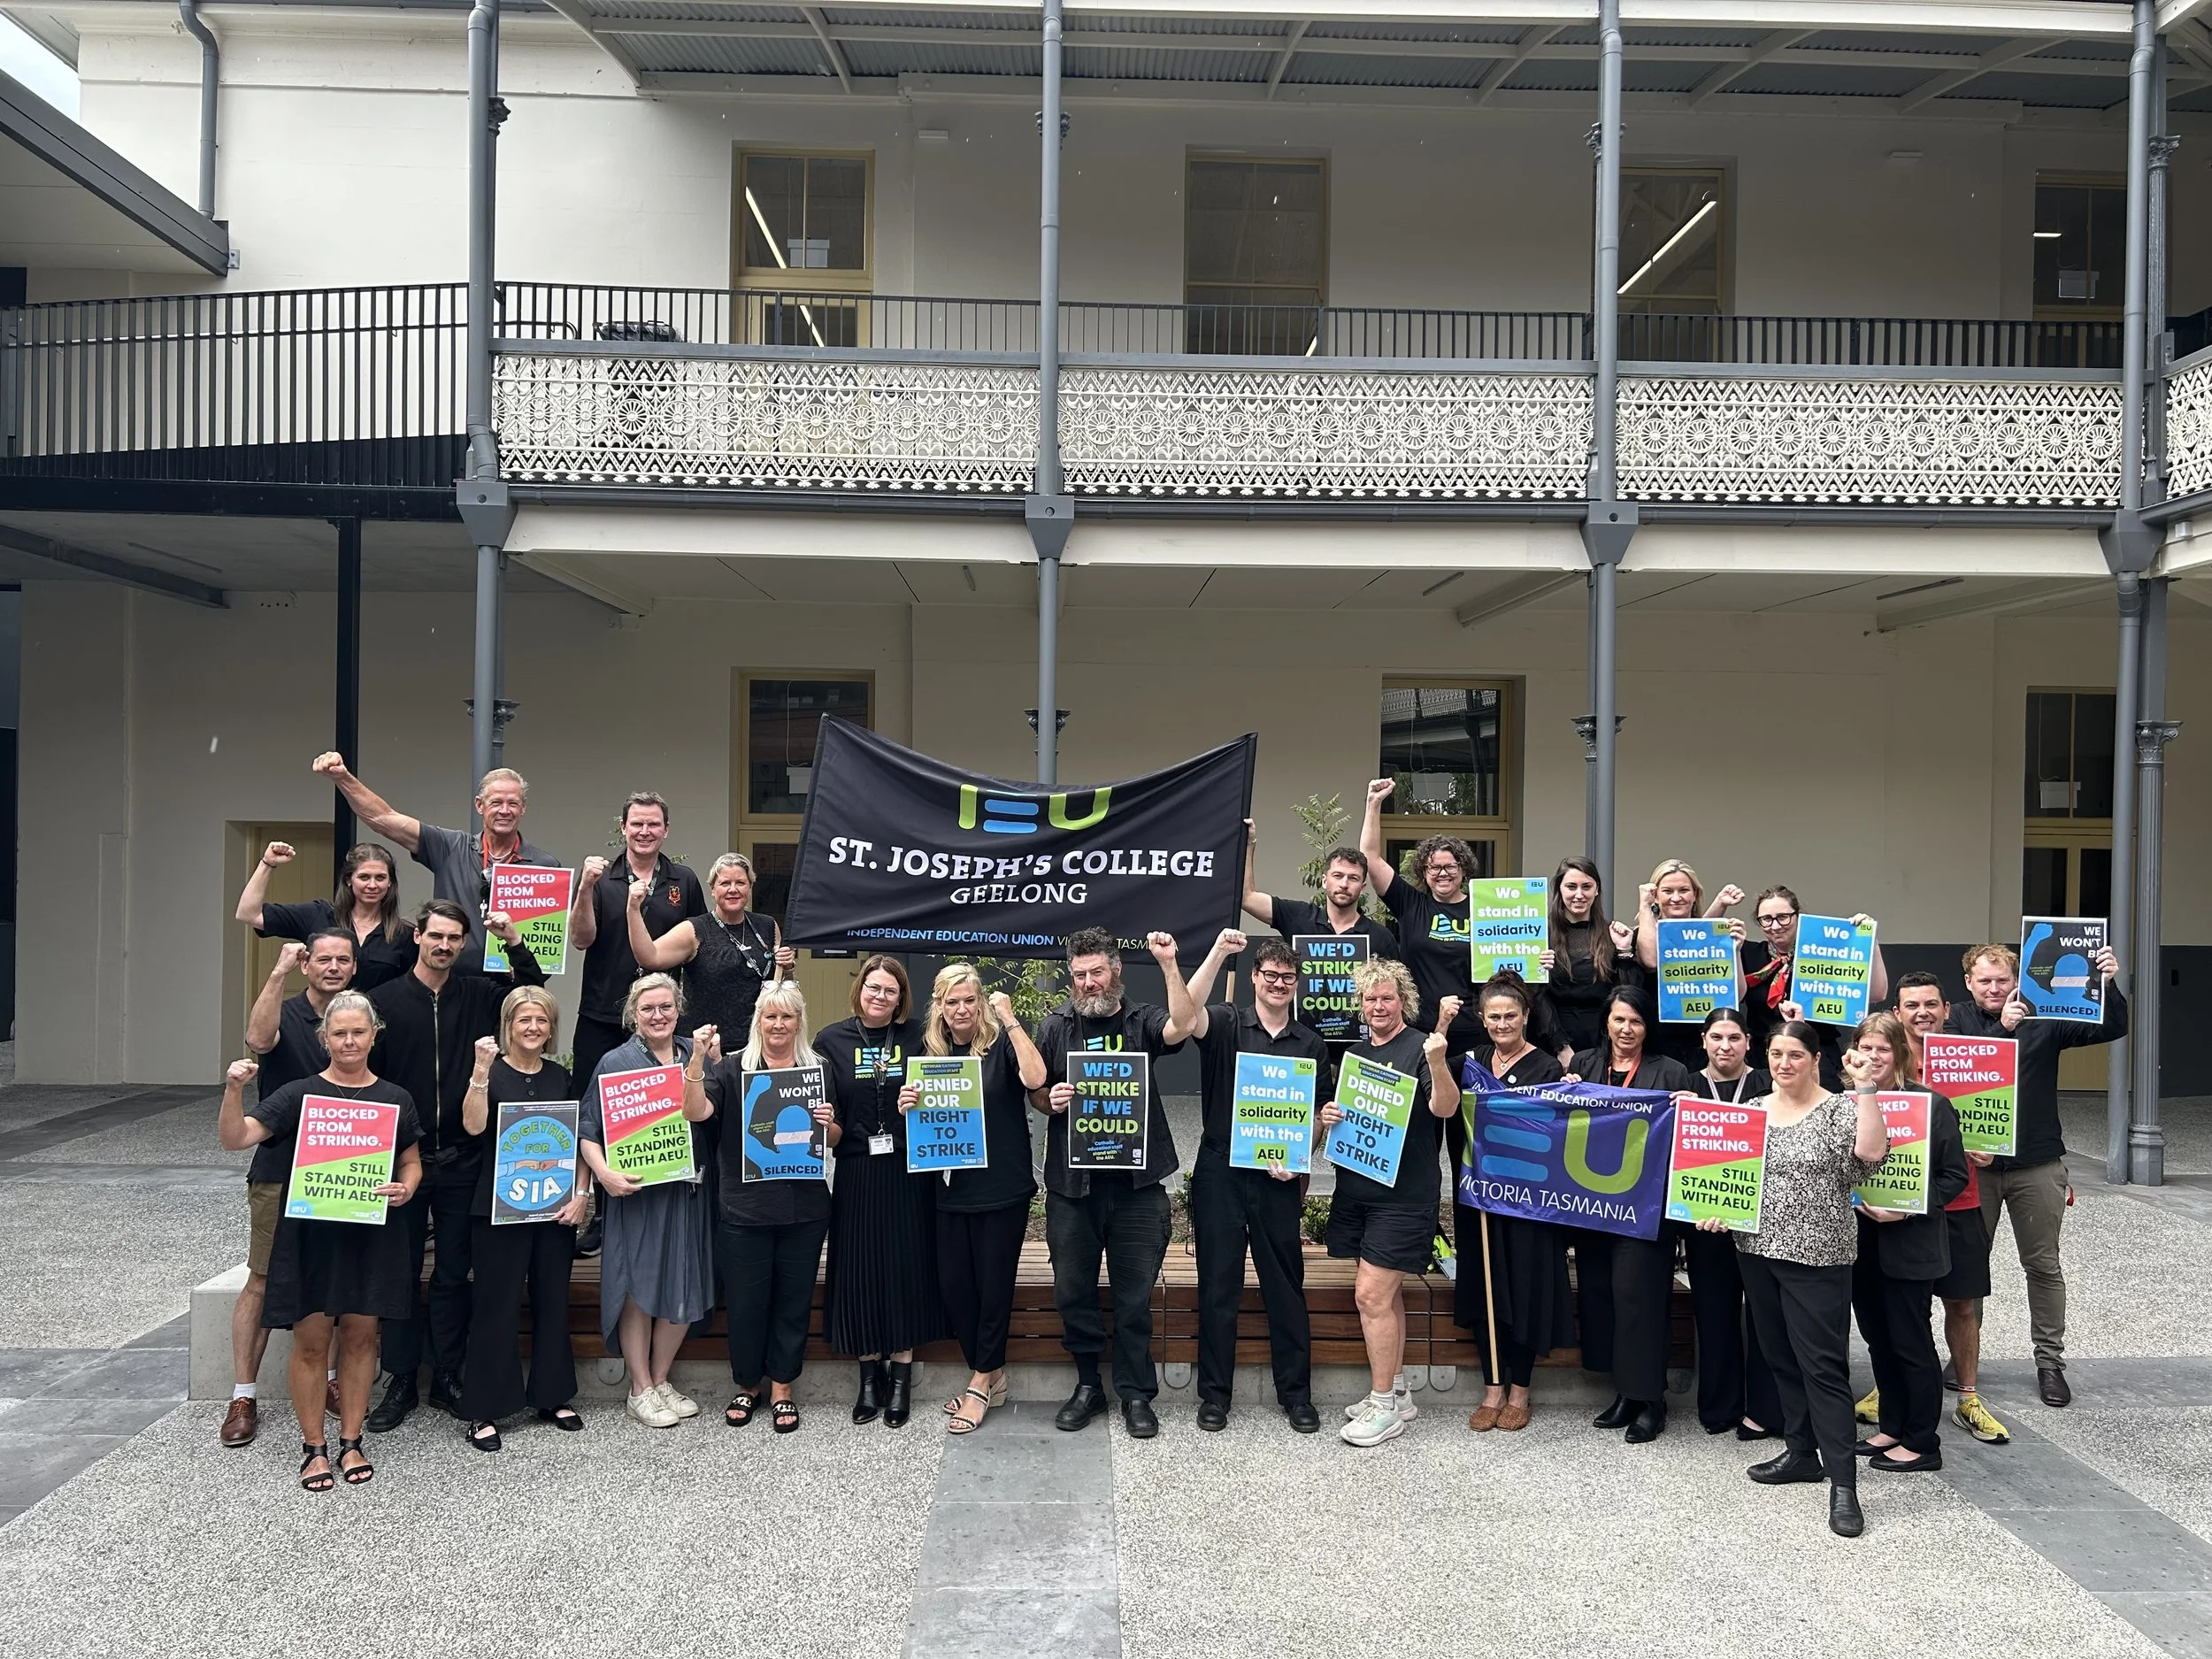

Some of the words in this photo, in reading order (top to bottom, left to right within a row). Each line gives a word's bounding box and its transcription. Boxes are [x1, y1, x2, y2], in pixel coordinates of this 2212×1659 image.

[958, 783, 1112, 833] IEU
[828, 836, 877, 869] ST.
[887, 845, 1051, 880] JOSEPH'S
[1063, 849, 1214, 877] COLLEGE
[497, 874, 556, 885] BLOCKED
[497, 887, 534, 896] FROM
[949, 883, 1087, 904] GEELONG
[1495, 887, 1520, 898] We
[497, 898, 559, 909] STRIKING.
[1478, 906, 1521, 917] stand
[1524, 905, 1538, 917] in
[533, 922, 563, 932] STILL
[1478, 924, 1541, 936] solidarity
[1824, 926, 1849, 940] We
[2084, 926, 2101, 935] WE
[497, 933, 561, 944] NDING
[847, 928, 933, 940] INDEPENDENT
[935, 931, 1008, 943] EDUCATION
[1011, 934, 1054, 946] UNION
[1682, 930, 1707, 940] We
[1479, 942, 1512, 955] with
[1515, 943, 1540, 955] the
[2060, 938, 2101, 947] WON'T
[531, 946, 560, 956] AEU.
[1308, 943, 1355, 956] WE'D
[1664, 947, 1708, 958] stand
[1710, 946, 1725, 957] in
[1801, 943, 1847, 958] stand
[1850, 947, 1863, 961] in
[1665, 964, 1728, 977] solidarity
[1800, 964, 1864, 980] solidarity
[1309, 979, 1324, 992] IF
[1327, 979, 1356, 993] WE
[1666, 982, 1700, 994] with
[1702, 983, 1728, 994] the
[1800, 980, 1834, 995] with
[1837, 985, 1861, 998] the
[1686, 1002, 1710, 1012] AEU
[1816, 1003, 1841, 1014] AEU
[2039, 1006, 2098, 1016] SILENCED!
[1930, 1045, 1997, 1056] BLOCKED
[1083, 1063, 1132, 1077] WE'D
[1931, 1059, 1972, 1069] FROM
[803, 1072, 820, 1083] WE
[1263, 1065, 1286, 1079] We
[1932, 1071, 2004, 1083] STRIKING.
[605, 1073, 666, 1098] BLOCKED
[912, 1079, 972, 1091] DENIED
[1076, 1081, 1139, 1096] STRIKE
[1347, 1075, 1404, 1106] DENIED
[779, 1086, 821, 1098] WON'T
[1241, 1085, 1286, 1100] stand
[1290, 1087, 1304, 1101] in
[608, 1091, 647, 1110] FROM
[924, 1094, 960, 1108] OUR
[1354, 1095, 1388, 1119] OUR
[1540, 1090, 1608, 1107] EDUCATION
[1612, 1102, 1652, 1113] UNION
[1975, 1098, 2009, 1110] STILL
[308, 1108, 378, 1119] BLOCKED
[611, 1098, 676, 1123] STRIKING.
[1083, 1100, 1098, 1113] IF
[1102, 1101, 1132, 1115] WE
[1240, 1106, 1307, 1122] solidarity
[919, 1111, 969, 1123] RIGHT
[1344, 1109, 1394, 1138] RIGHT
[1682, 1111, 1748, 1124] BLOCKED
[308, 1121, 352, 1133] FROM
[653, 1124, 685, 1137] STILL
[1076, 1118, 1139, 1133] COULD
[1682, 1125, 1723, 1137] FROM
[1978, 1125, 2008, 1136] AEU.
[502, 1121, 572, 1153] TOGETHER
[933, 1127, 956, 1140] TO
[1240, 1125, 1274, 1140] with
[1279, 1128, 1303, 1141] the
[1356, 1130, 1376, 1148] TO
[307, 1135, 382, 1147] STRIKING.
[617, 1136, 686, 1156] STANDING
[1462, 1091, 1649, 1194] IEU
[1682, 1139, 1753, 1153] STRIKING.
[526, 1143, 549, 1153] FOR
[918, 1143, 975, 1157] STRIKE
[1257, 1149, 1284, 1160] AEU
[619, 1155, 654, 1169] WITH
[658, 1149, 687, 1163] AEU.
[1335, 1141, 1390, 1172] STRIKE
[1889, 1154, 1921, 1164] STILL
[349, 1163, 385, 1175] STILL
[764, 1165, 823, 1175] SILENCED!
[1722, 1168, 1756, 1183] STILL
[1877, 1166, 1921, 1178] NDING
[304, 1171, 384, 1187] STANDING
[1889, 1180, 1920, 1191] AEU.
[509, 1177, 563, 1203] SIA
[1681, 1176, 1755, 1196] STANDING
[304, 1186, 344, 1199] WITH
[349, 1190, 381, 1202] AEU.
[1681, 1190, 1718, 1204] WITH
[1722, 1197, 1754, 1210] AEU.
[1540, 1190, 1636, 1224] TASMANIA
